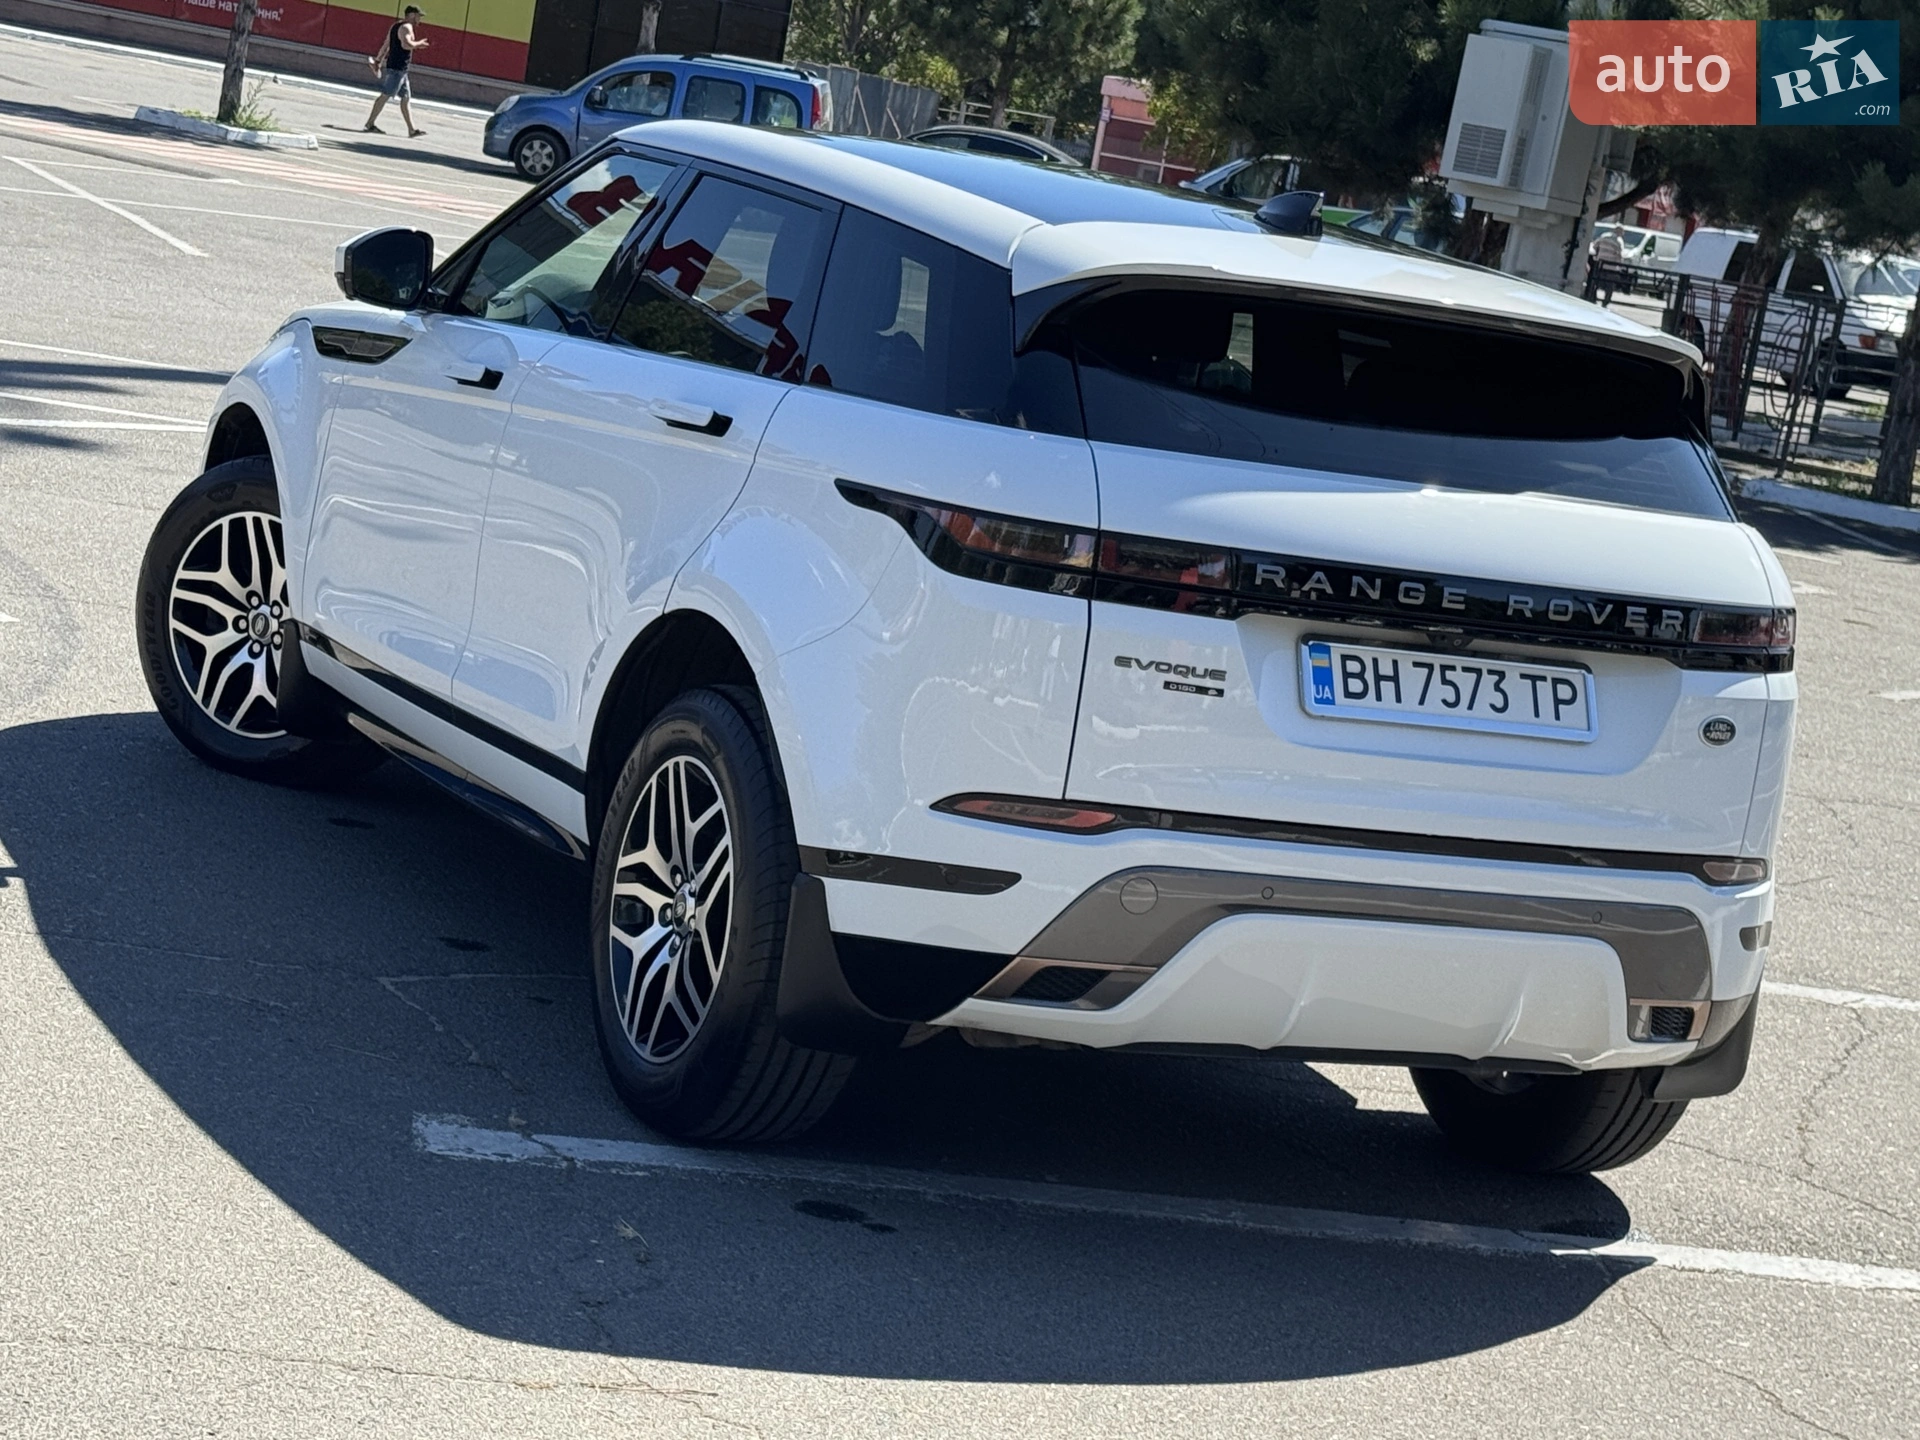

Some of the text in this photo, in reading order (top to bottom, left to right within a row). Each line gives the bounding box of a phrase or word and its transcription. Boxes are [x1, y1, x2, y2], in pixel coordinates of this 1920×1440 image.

[1254, 563, 1685, 633] RANGE ROVER
[1114, 655, 1227, 682] EVOQUE
[1313, 683, 1332, 700] UA
[1340, 653, 1578, 722] BH 7573 TP
